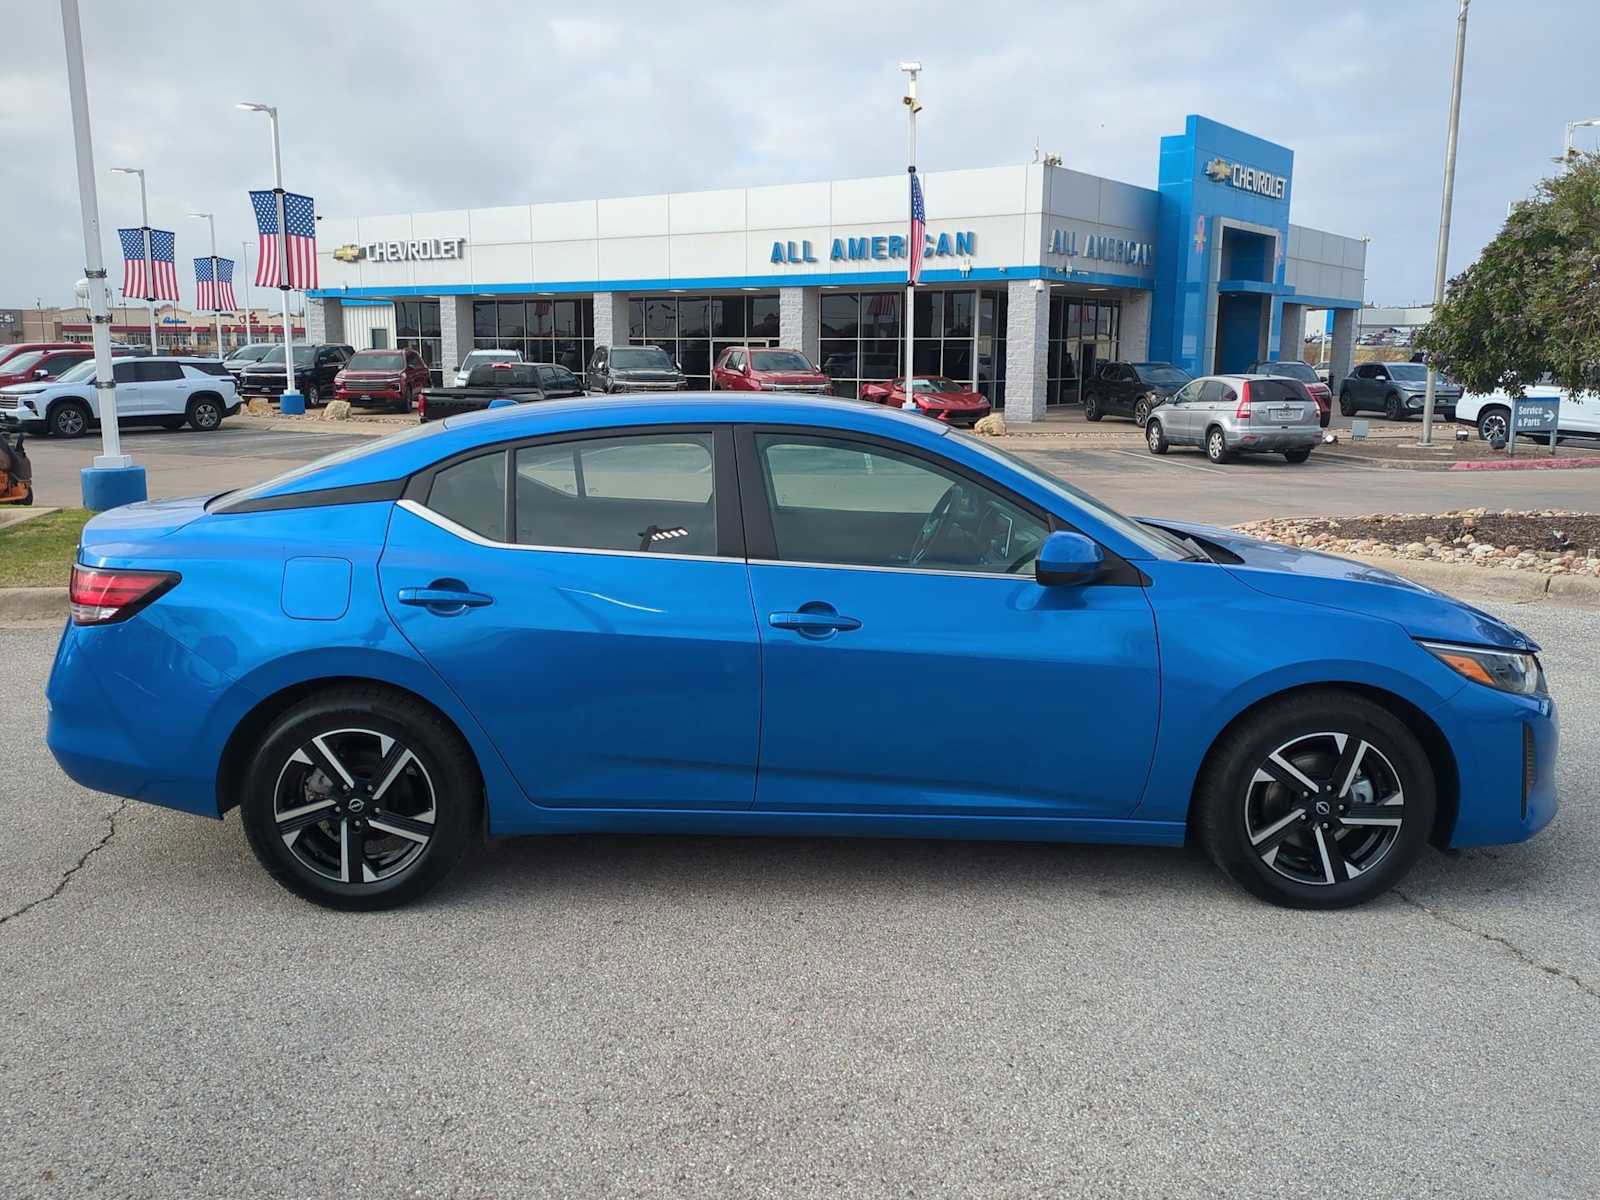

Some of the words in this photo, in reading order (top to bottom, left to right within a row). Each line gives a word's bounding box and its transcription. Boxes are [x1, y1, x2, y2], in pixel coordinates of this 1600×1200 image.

[1232, 163, 1287, 199] CHEVROLET
[365, 238, 466, 262] CHEVROLET
[770, 240, 817, 264] ALL
[830, 232, 976, 262] AMERAN
[1048, 230, 1079, 256] ALL
[1517, 418, 1522, 427] &
[1523, 417, 1541, 427] Parts
[1518, 405, 1543, 415] Service
